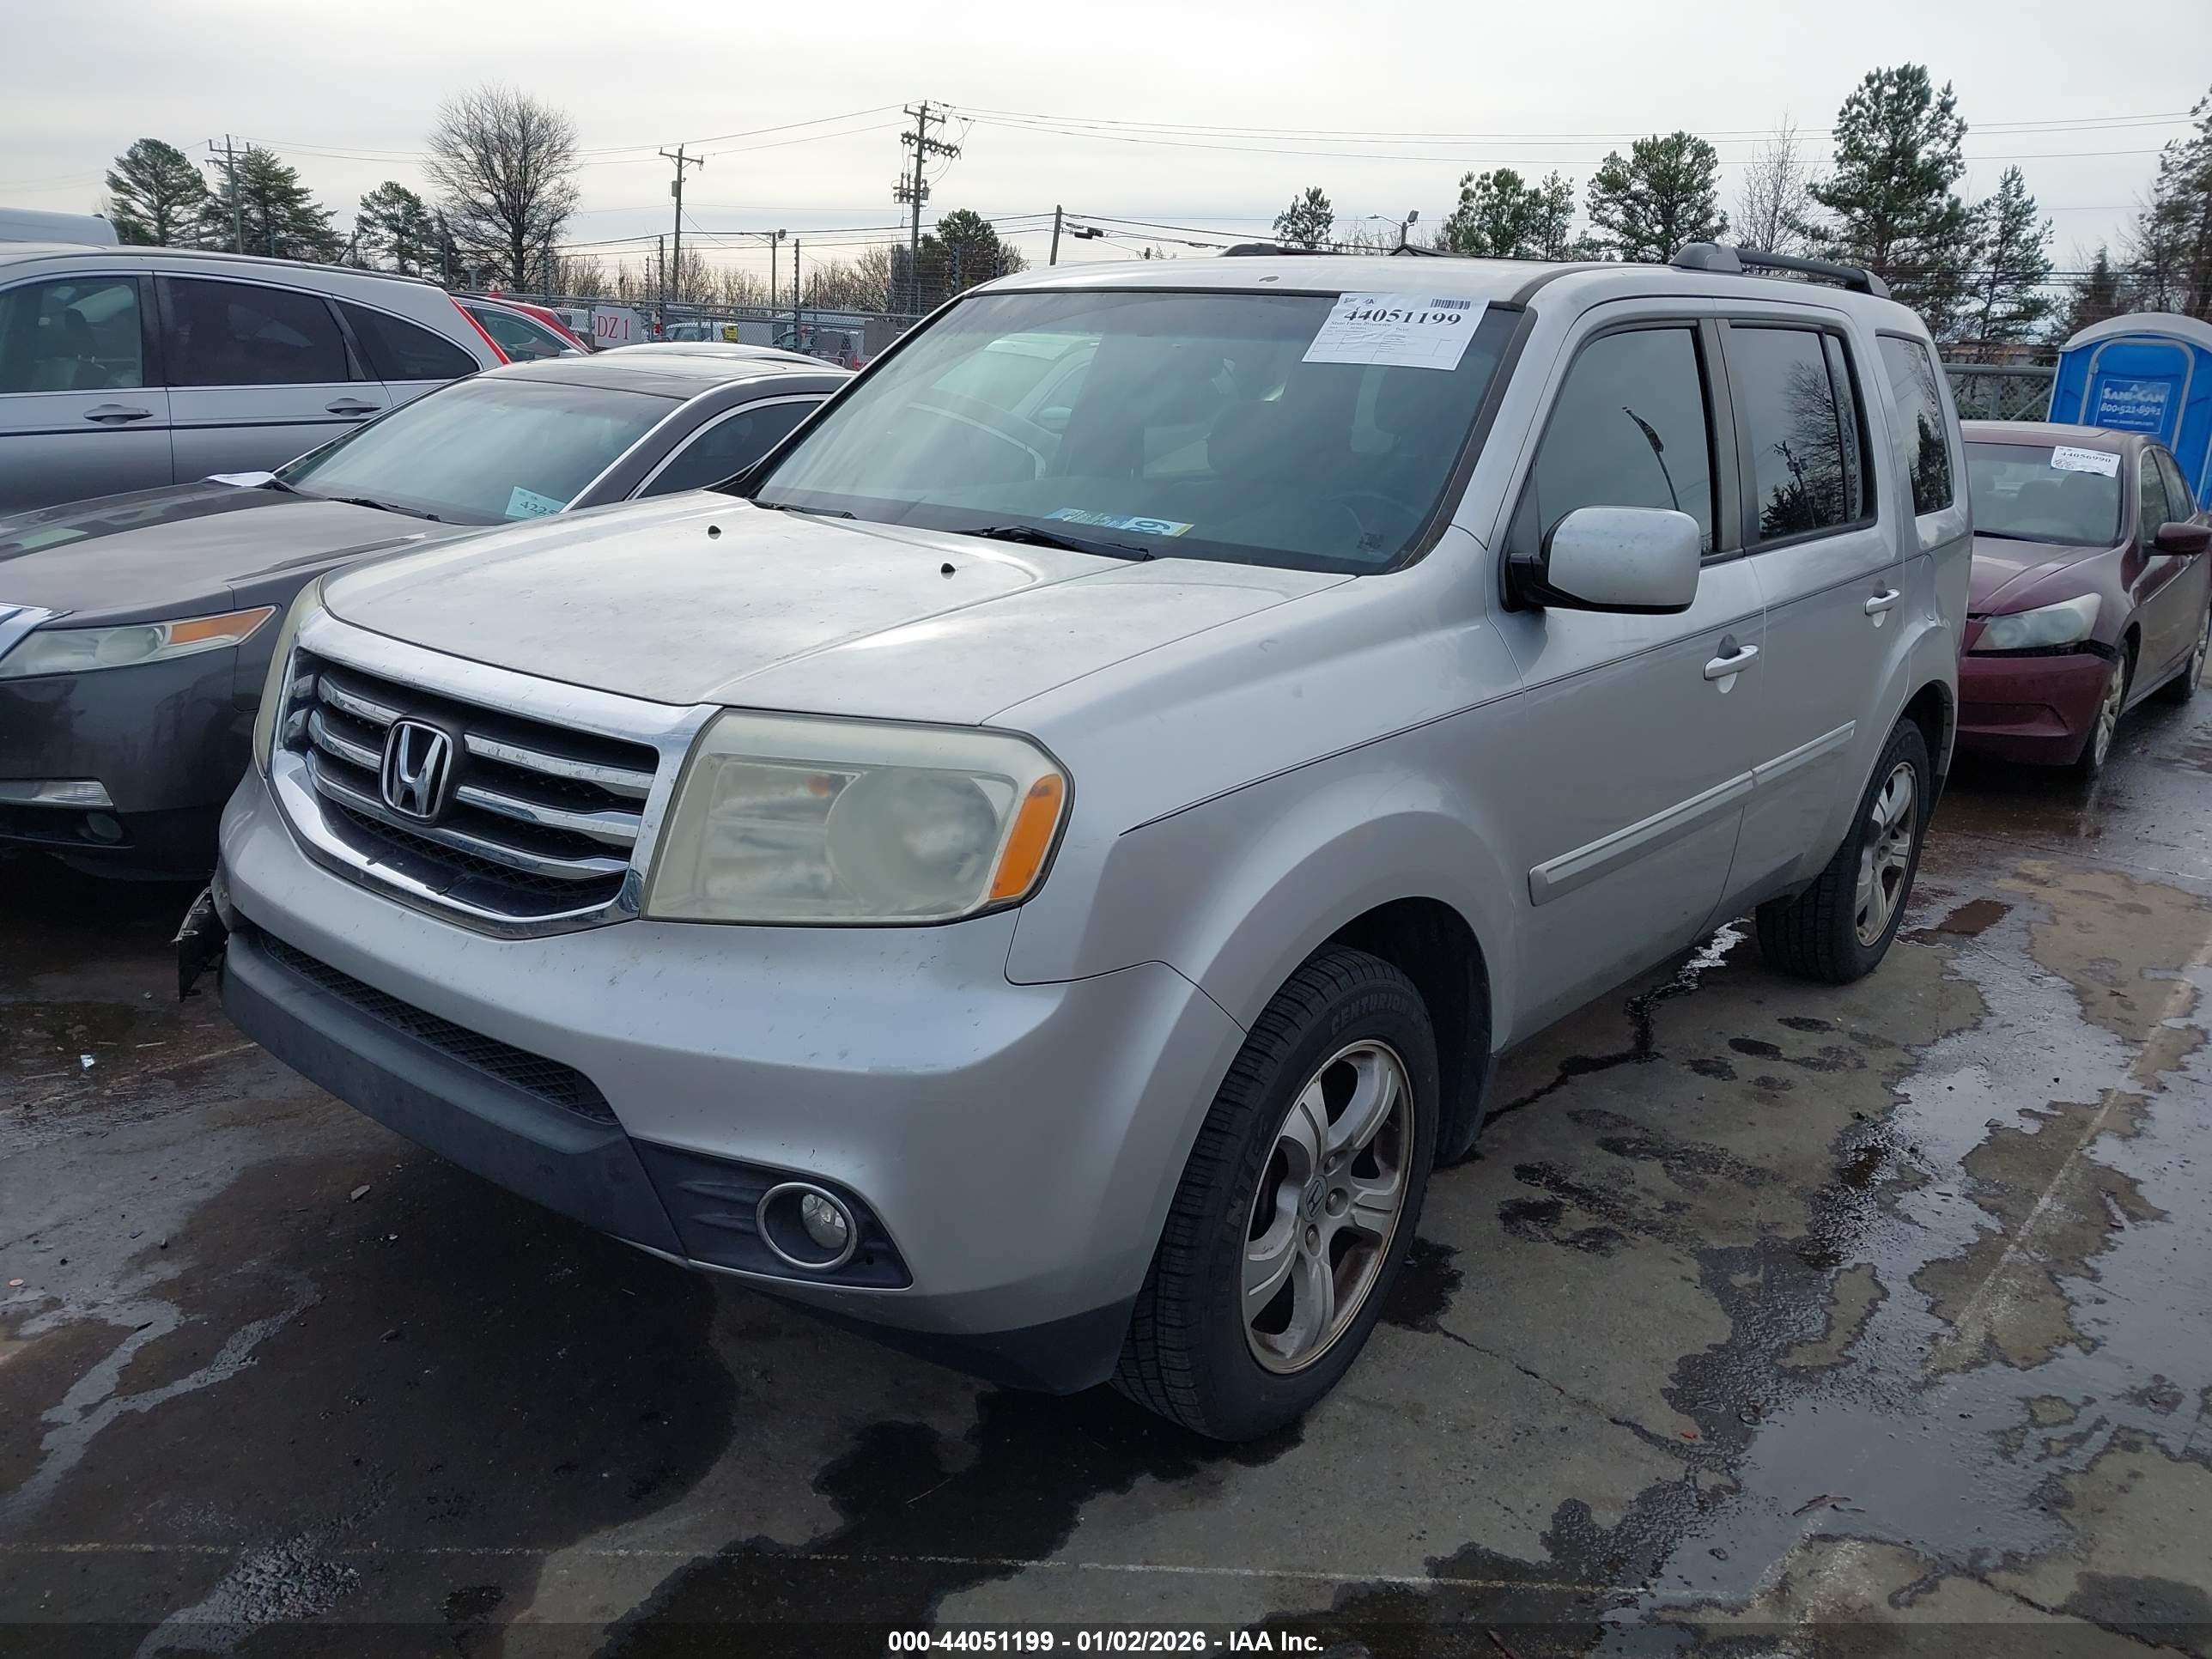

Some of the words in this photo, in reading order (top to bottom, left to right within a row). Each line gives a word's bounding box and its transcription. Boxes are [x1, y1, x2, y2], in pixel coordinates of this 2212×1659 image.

[597, 315, 618, 338] DZ
[623, 318, 631, 340] 1
[1344, 307, 1462, 326] 44051199
